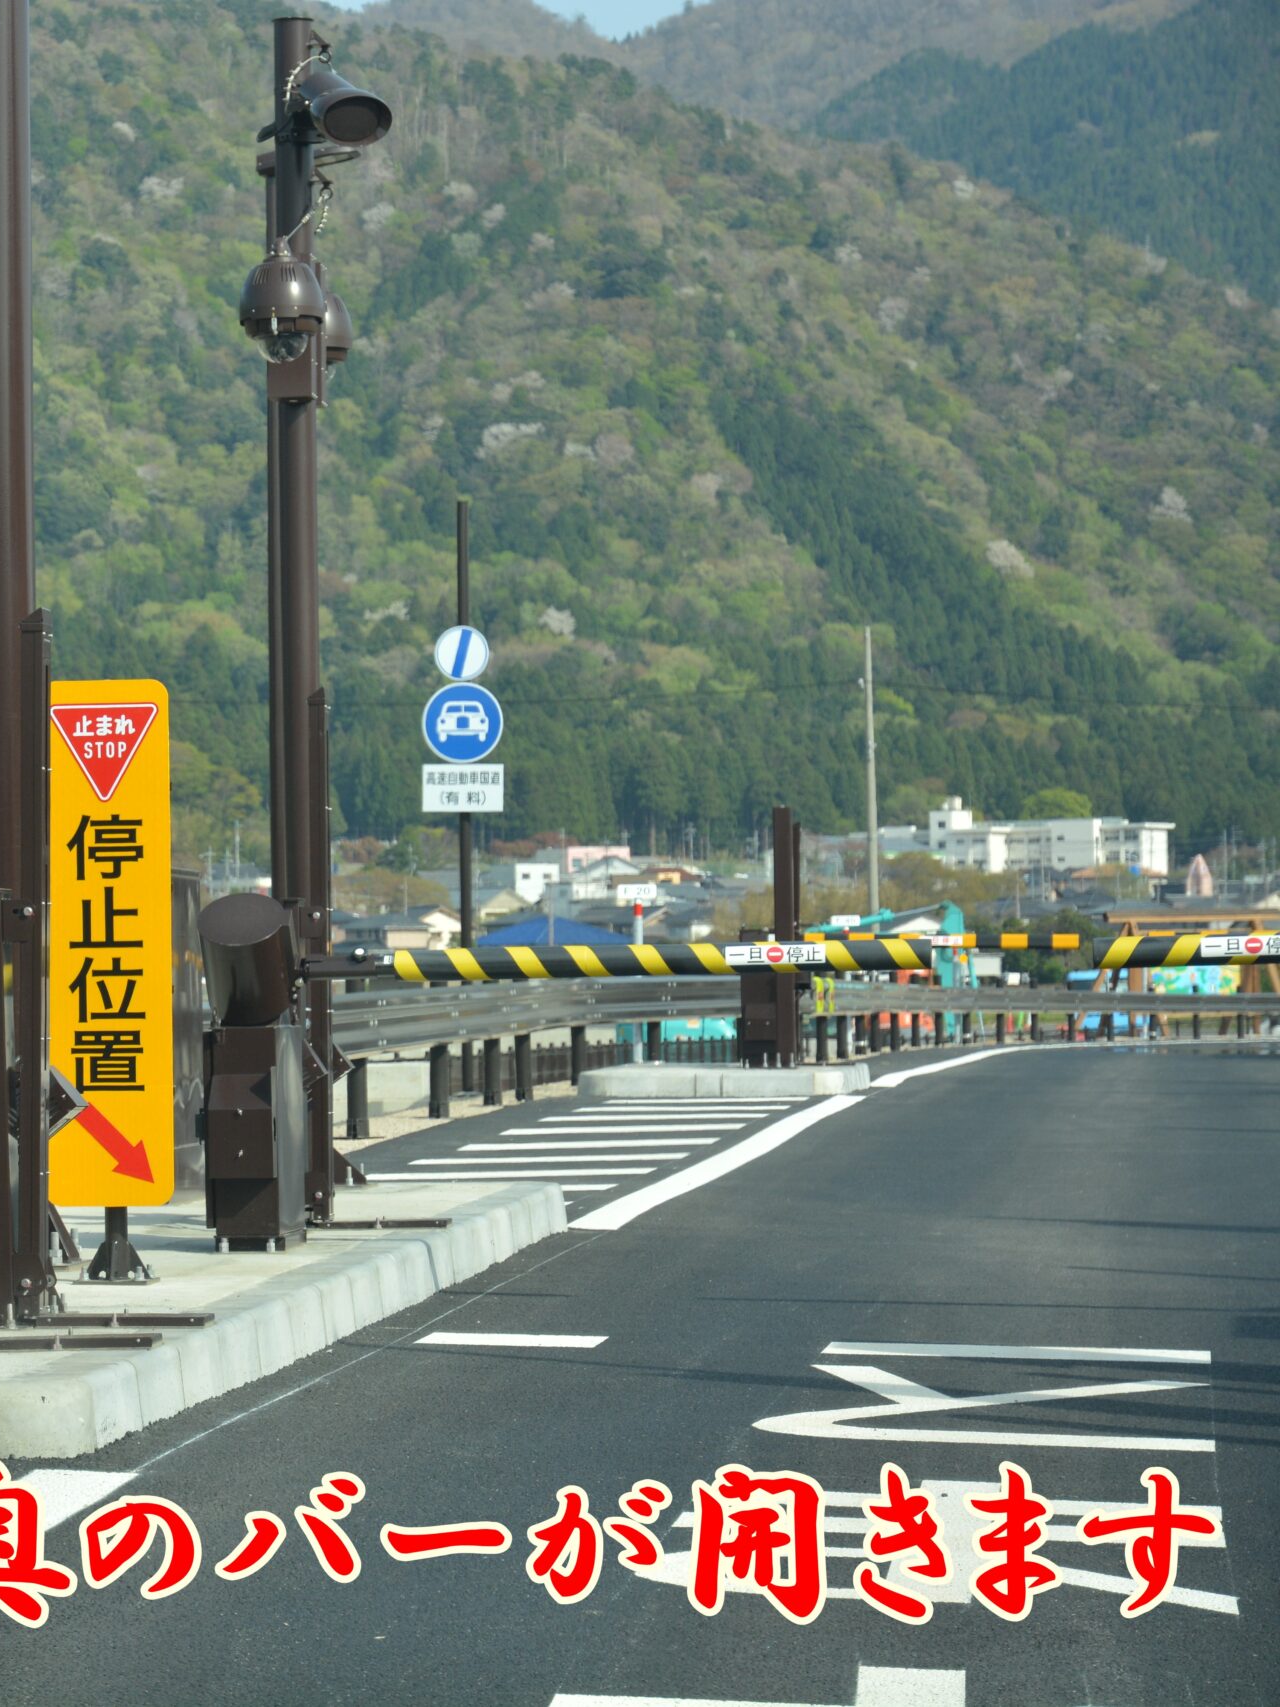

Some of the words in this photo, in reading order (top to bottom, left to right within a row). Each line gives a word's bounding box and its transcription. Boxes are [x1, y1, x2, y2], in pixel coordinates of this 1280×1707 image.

[73, 714, 136, 738] 止まれ
[83, 741, 128, 759] STOP
[426, 771, 500, 785] 高速自動車国道
[66, 813, 147, 1094] 停止位置
